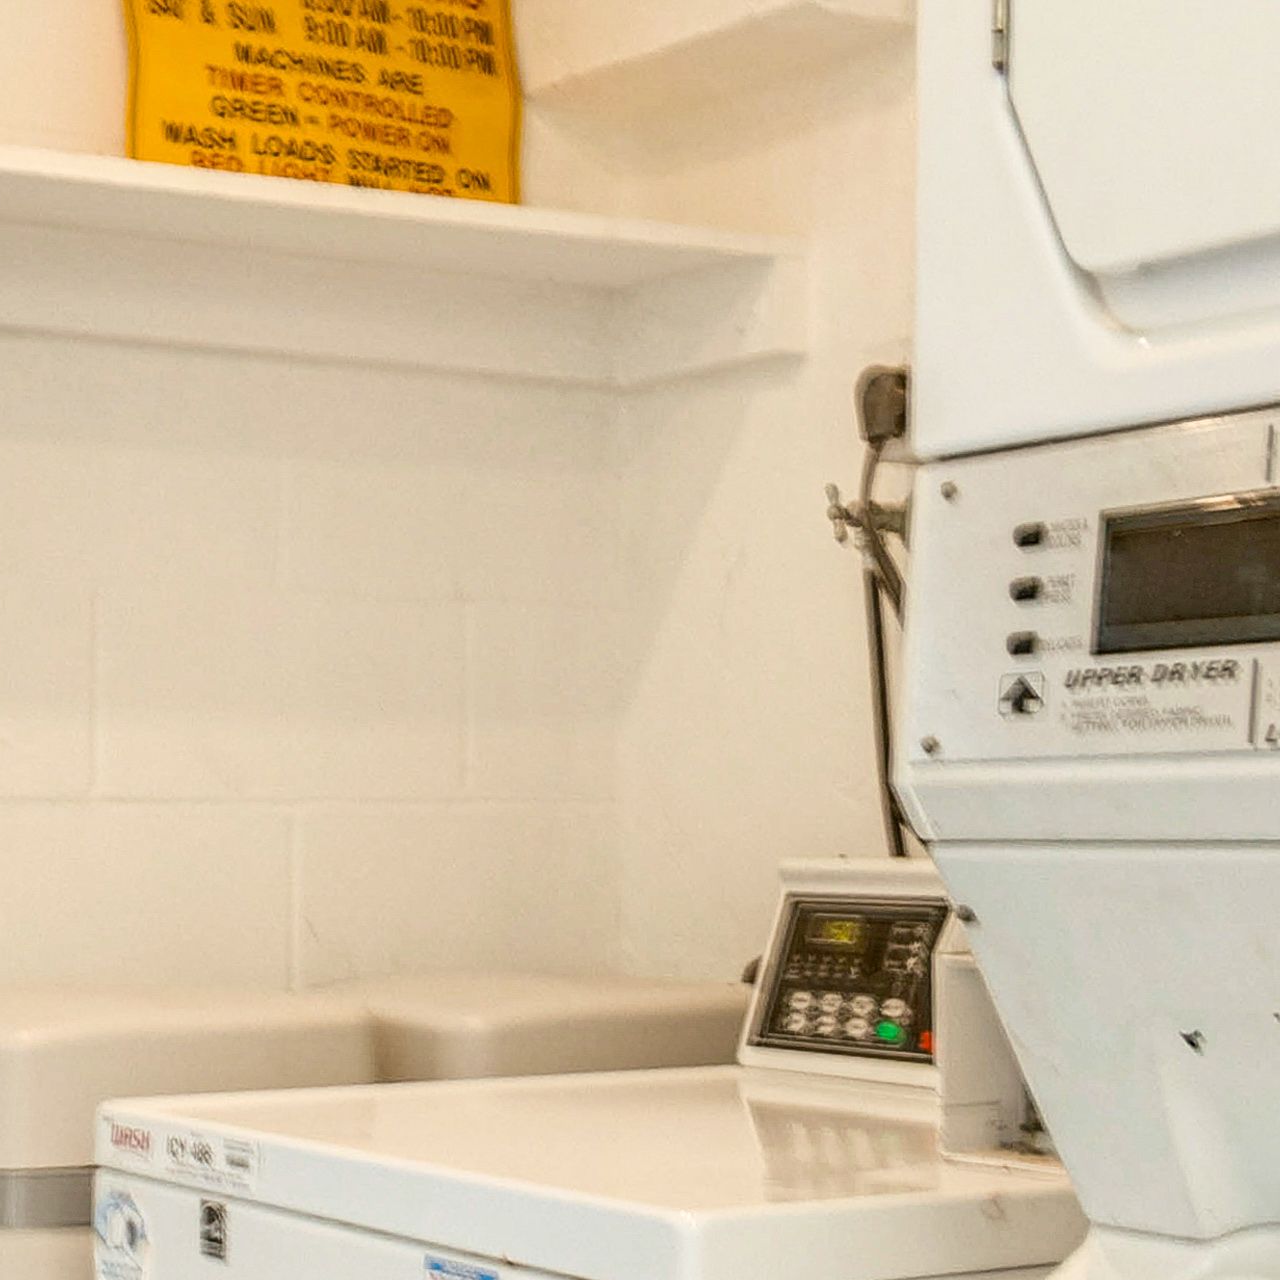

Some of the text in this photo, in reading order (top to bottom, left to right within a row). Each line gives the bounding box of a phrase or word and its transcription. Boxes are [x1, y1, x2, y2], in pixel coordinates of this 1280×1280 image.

[228, 2, 276, 34] SUN
[355, 26, 389, 56] AM
[464, 48, 497, 76] PM
[462, 17, 494, 46] PM
[206, 64, 456, 129] TIMER CONTROLLED
[235, 42, 424, 96] MACHINES ARE
[211, 95, 300, 126] GREEN
[329, 113, 411, 148] POWER
[416, 131, 452, 155] ON
[163, 120, 492, 192] WASH LOADS STARTED ON
[1064, 658, 1239, 688] UPPER DRYER
[110, 1121, 151, 1151] WASH
